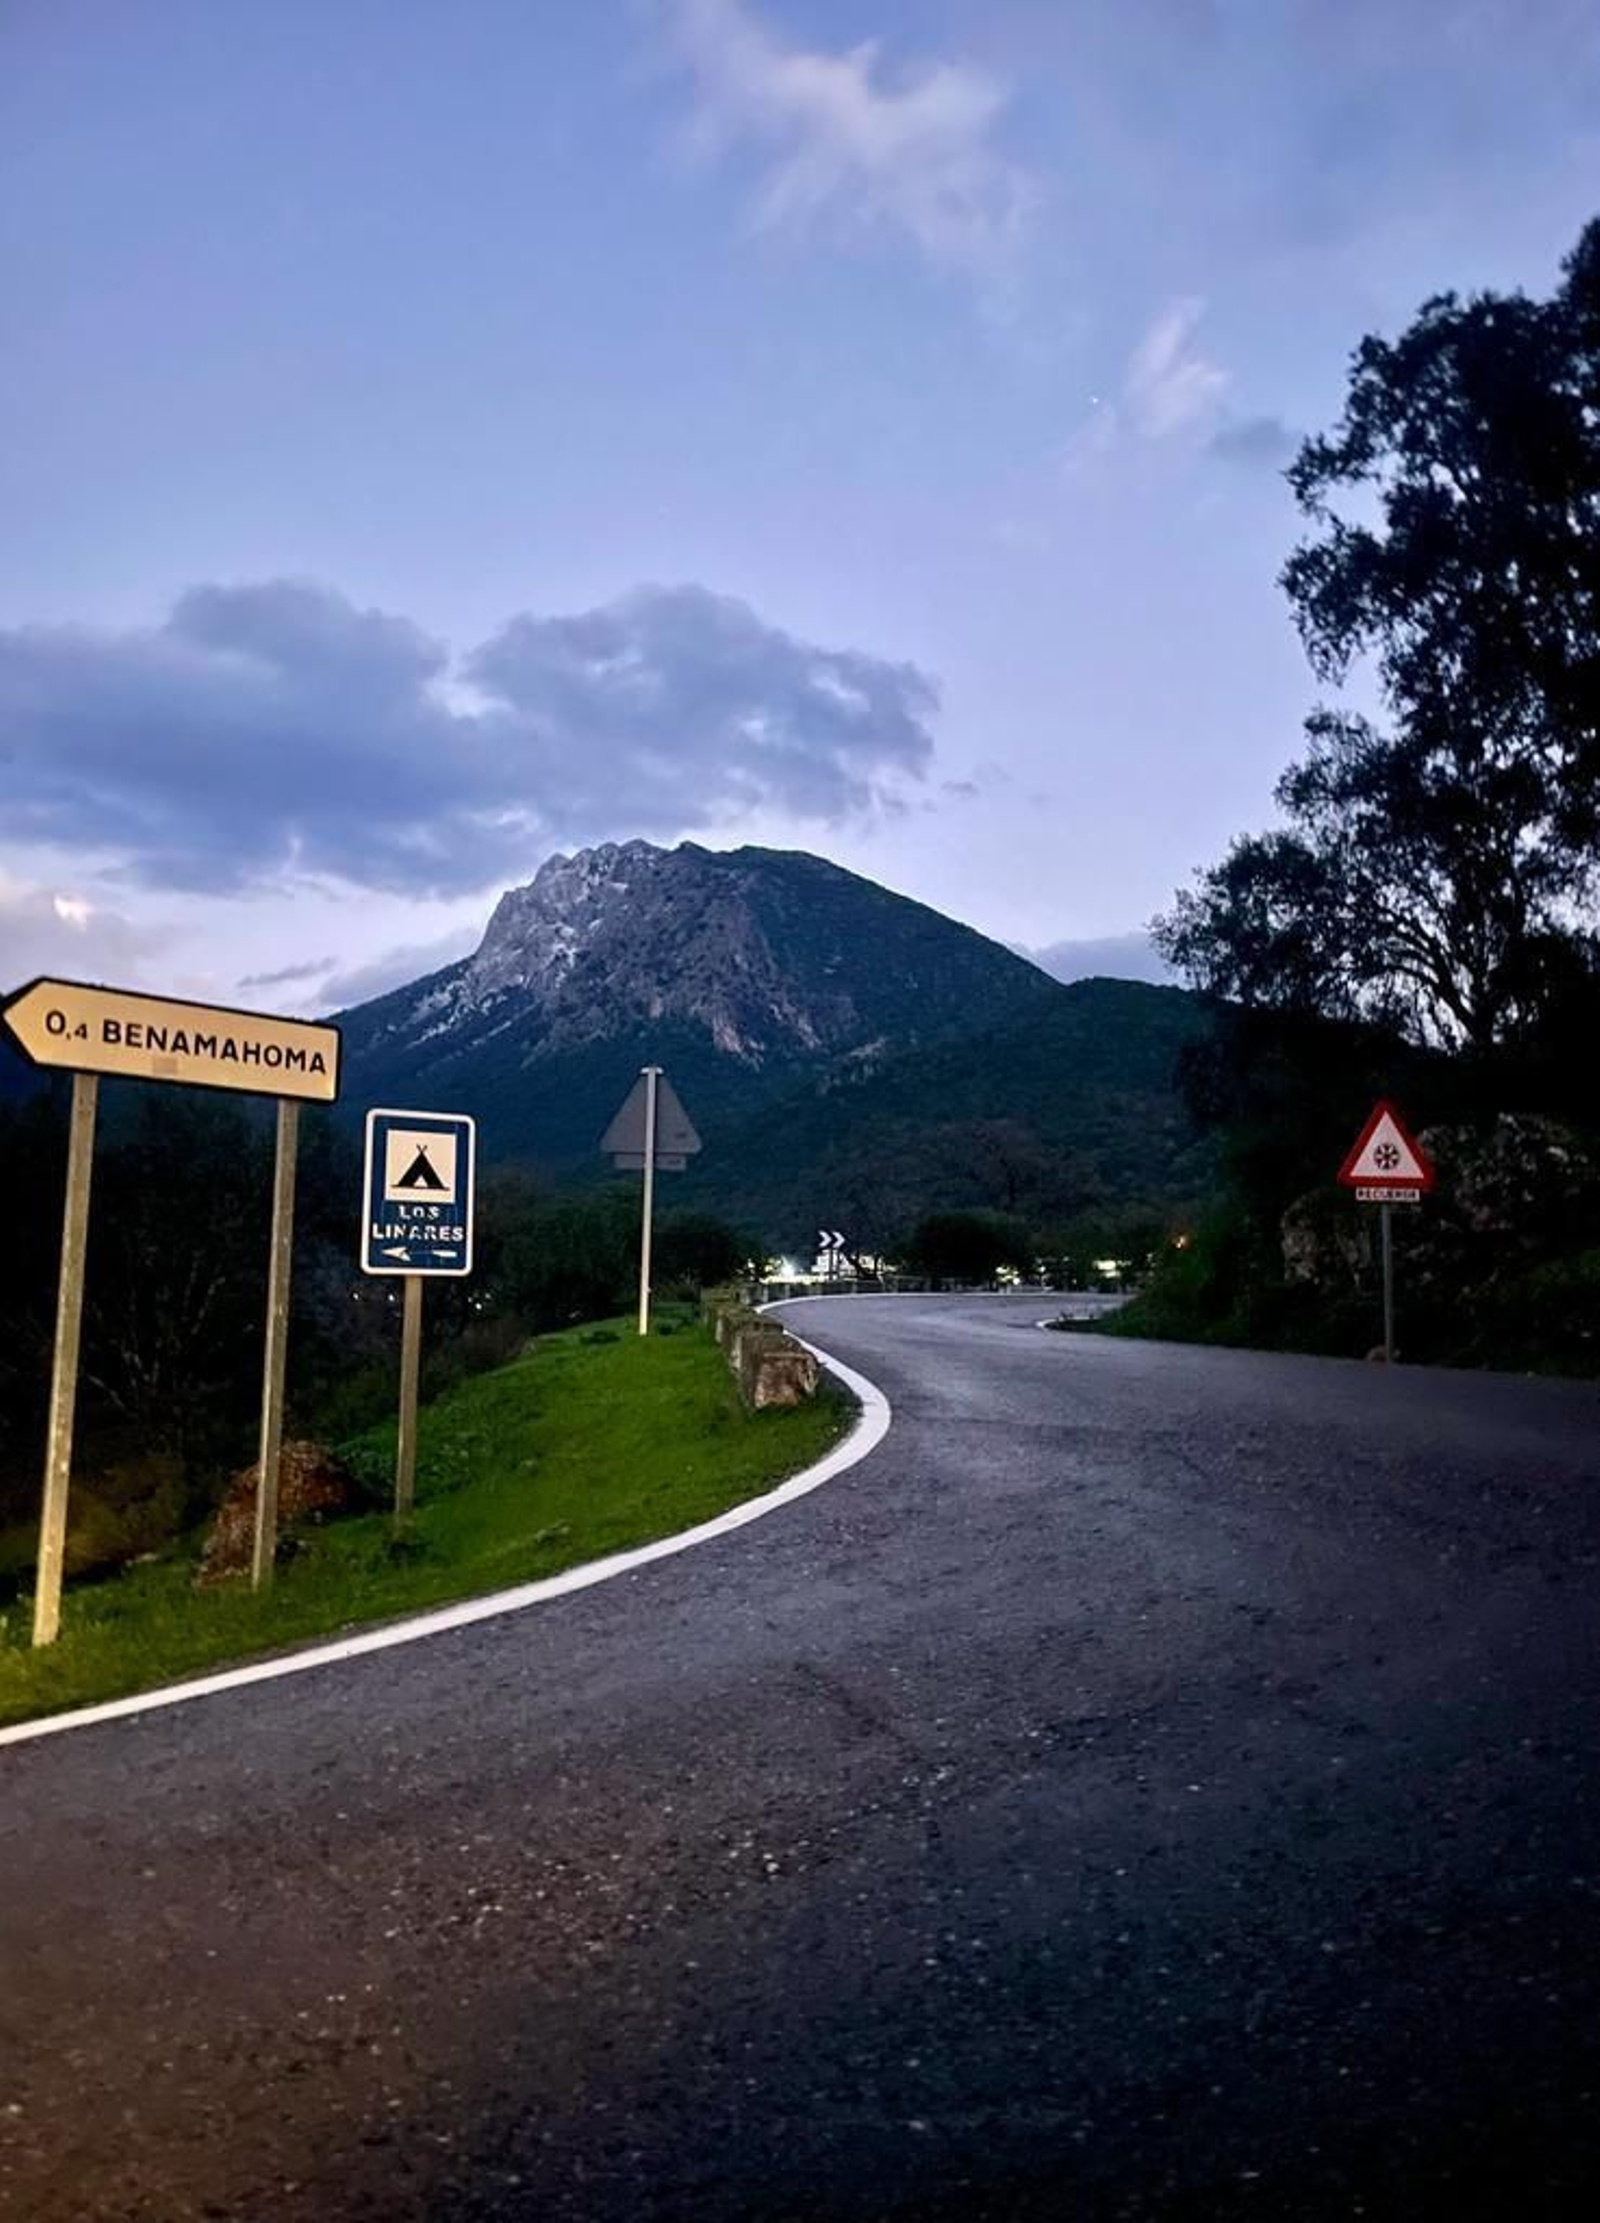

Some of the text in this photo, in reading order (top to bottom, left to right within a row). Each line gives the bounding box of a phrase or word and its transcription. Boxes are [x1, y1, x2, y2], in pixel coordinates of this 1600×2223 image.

[102, 1018, 327, 1074] BENAMAHOMA
[398, 1204, 441, 1220] LOS
[372, 1223, 464, 1242] LINARES
